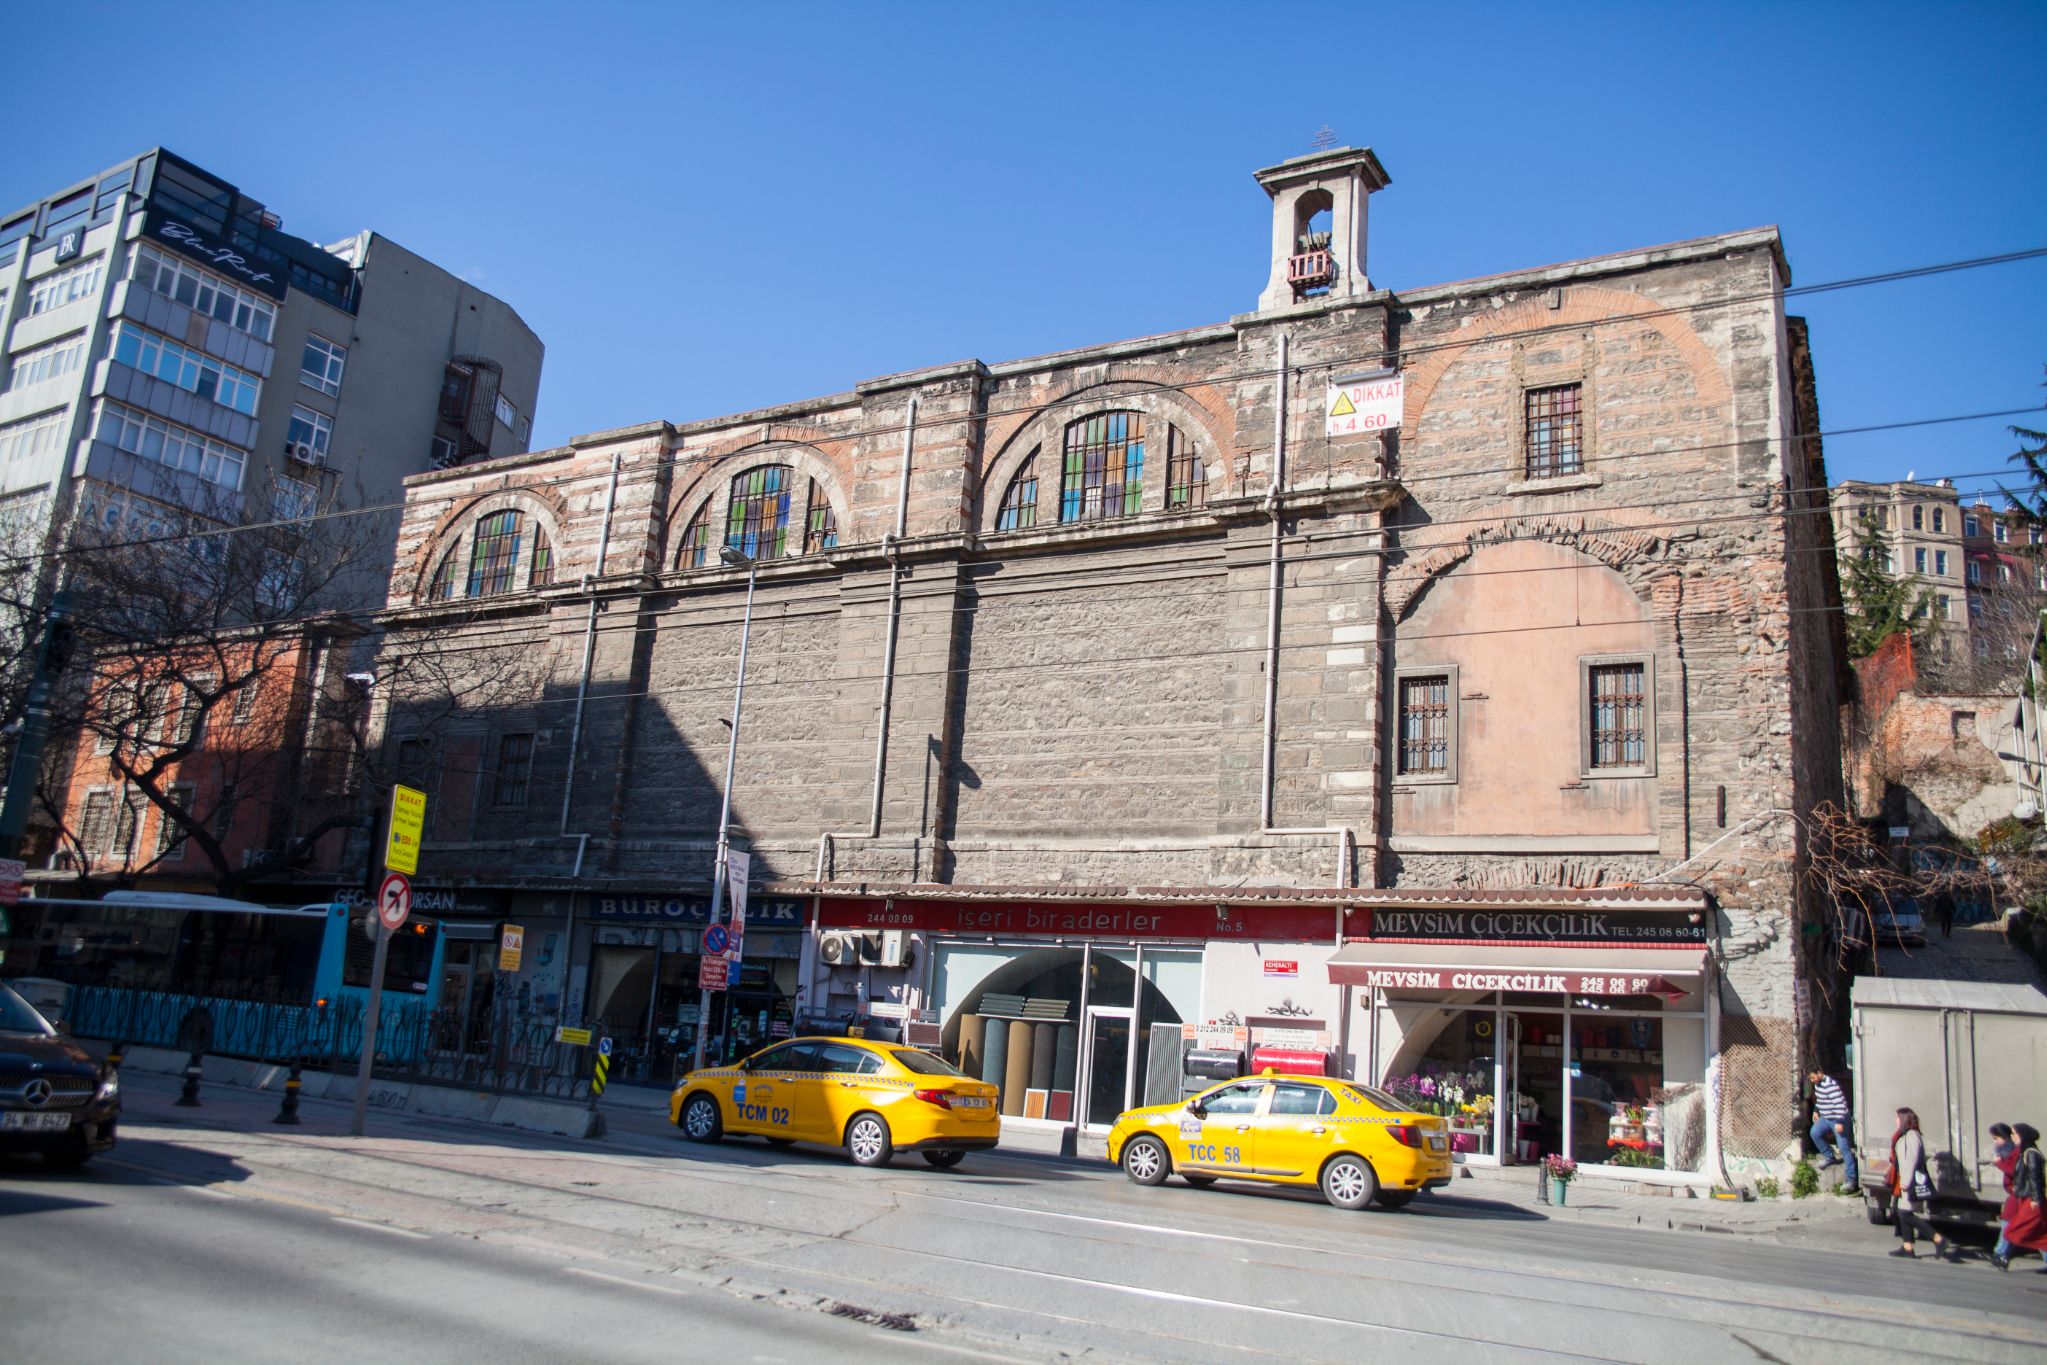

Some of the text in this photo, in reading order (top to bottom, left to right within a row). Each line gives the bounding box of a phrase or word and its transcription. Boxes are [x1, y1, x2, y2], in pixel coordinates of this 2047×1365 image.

[160, 221, 217, 256] Blue
[867, 913, 914, 924] 244 09 09
[1026, 907, 1162, 932] biraderler
[1636, 928, 1656, 937] 245
[1658, 928, 1673, 937] 06
[1675, 928, 1705, 938] 60-61
[1581, 977, 1604, 986] 245
[1609, 978, 1626, 987] 06
[1632, 979, 1648, 988] 60
[1340, 1087, 1362, 1105] TAXI
[737, 1102, 789, 1125] TCM 02
[1188, 1143, 1241, 1163] TCC 58
